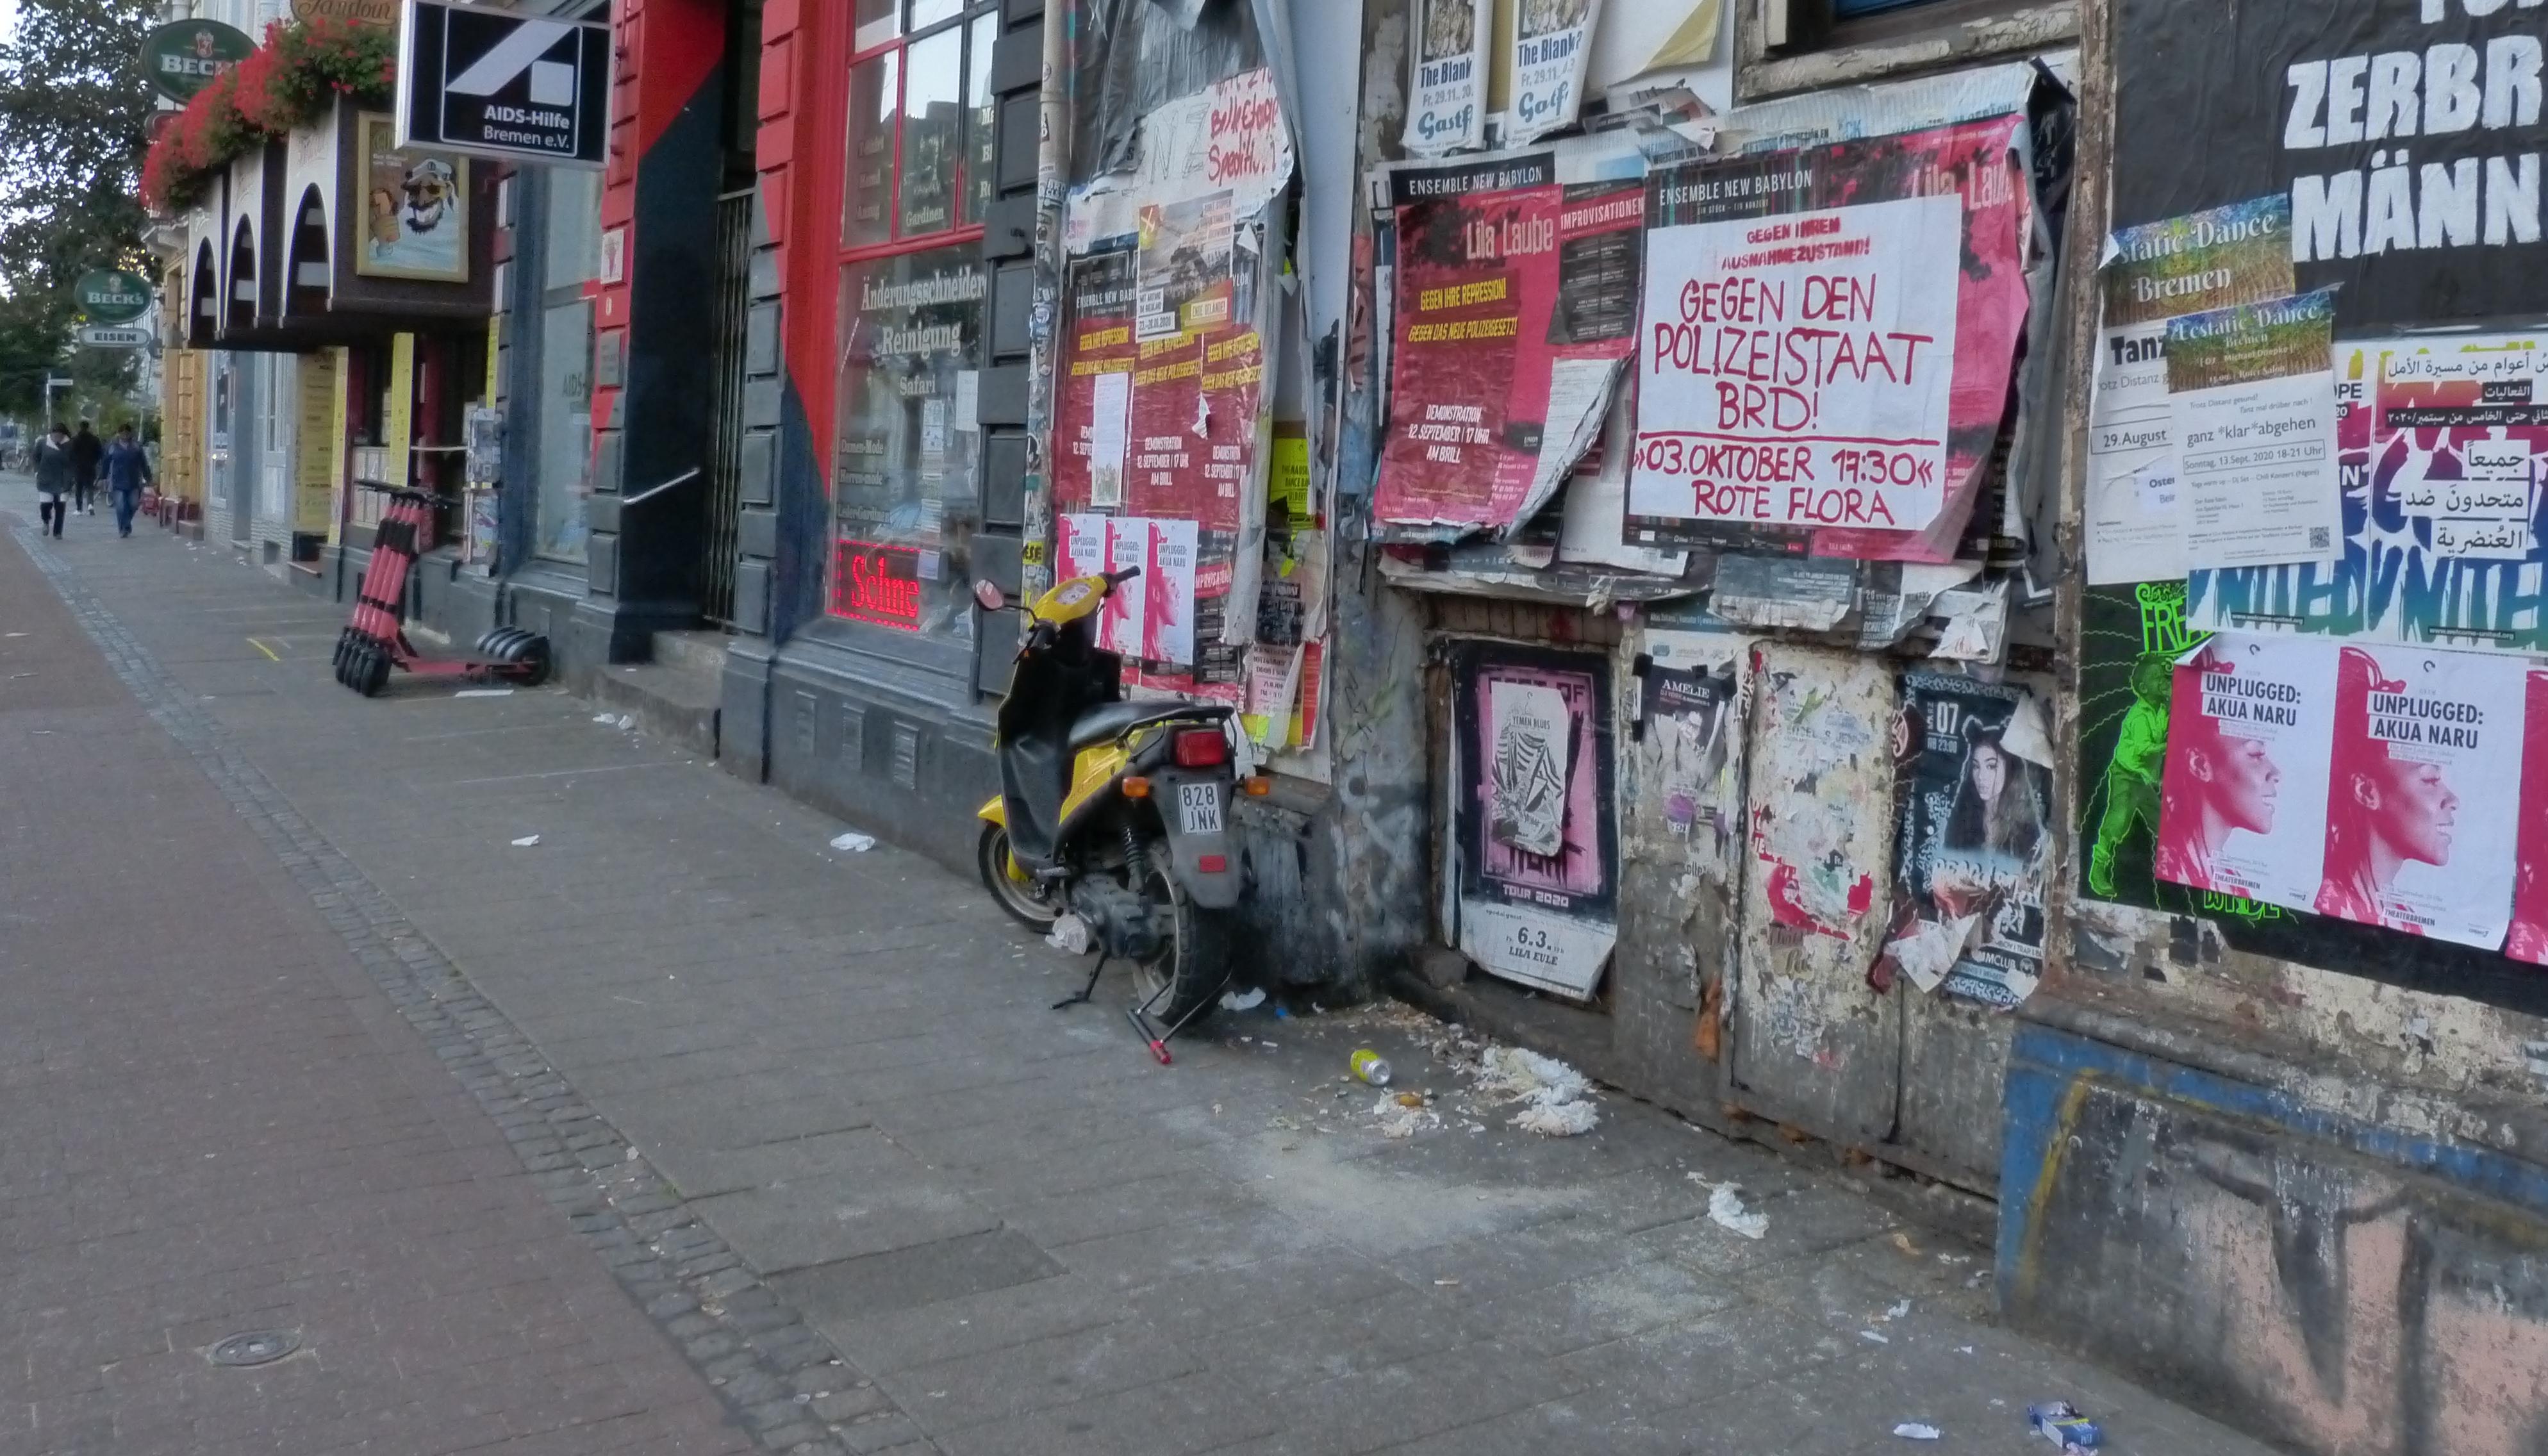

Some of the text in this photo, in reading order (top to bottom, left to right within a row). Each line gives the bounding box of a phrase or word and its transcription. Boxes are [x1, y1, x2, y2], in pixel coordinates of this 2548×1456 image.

[1518, 44, 1537, 67] The
[1421, 67, 1438, 88] The
[484, 104, 570, 129] AIDS-Hilfe
[484, 125, 570, 149] Bremen e.V.
[1410, 175, 1469, 196] ENSEMBLE
[1473, 172, 1494, 190] NEW
[1499, 165, 1543, 188] BABYLON
[1660, 169, 1813, 206] ENSEMBLE NEW BABYLON
[906, 206, 945, 227] Gardinen
[1561, 197, 1644, 231] IMPROVISATIONEN
[2292, 149, 2540, 262] MÄNN
[1467, 213, 1553, 260] Lila Laube
[1746, 224, 1791, 245] GEGEN
[2119, 213, 2274, 264] static Dance
[1421, 277, 1507, 312] GEGEN IHRE REPRESSION!
[2131, 267, 2231, 303] Bremen
[1105, 291, 1117, 304] NEW
[1680, 275, 1785, 326] GEGEN
[1801, 273, 1876, 323] DEN
[2253, 305, 2319, 330] Dance
[94, 332, 136, 342] EISEN
[881, 320, 961, 360] Reinigung
[1408, 317, 1518, 342] GEGEN DAS NEUE POLIZEIGESETZ!
[1654, 320, 1934, 388] POLIZEISTAAT
[2493, 351, 2530, 377] أعوام
[2388, 356, 2420, 377] الأمل
[2426, 360, 2463, 378] مسيرة
[2469, 360, 2488, 376] من
[900, 374, 936, 395] Safari
[2121, 374, 2159, 388] Distanz
[2483, 385, 2531, 399] الفعاليات
[1425, 403, 1482, 423] DEMONSTRATION
[1714, 381, 1819, 433] BRD!
[2449, 413, 2463, 424] من
[1409, 423, 1491, 445] 12. SEPTEMBER 17 UHR
[2103, 429, 2167, 448] 29.August
[2187, 431, 2214, 448] ganz
[1426, 445, 1461, 464] AM BRILL
[2253, 450, 2274, 462] 2020
[2276, 447, 2301, 459] 18-21
[2304, 445, 2323, 456] Uhr
[2467, 441, 2525, 475] جميعاً
[1691, 479, 1896, 526] ROTE FLORA
[2405, 488, 2435, 506] ضد
[1159, 557, 1171, 567] AKUA
[2429, 627, 2516, 640] www.welcome-united.org
[1662, 679, 1710, 699] AMELIE
[2206, 674, 2301, 704] UNPLUGGED:
[1936, 701, 1959, 735] 07
[2207, 697, 2296, 727] AKUA NARU
[2373, 693, 2484, 725] UNPLUGGED:
[1512, 715, 1532, 728] YEMEN
[2374, 718, 2478, 750] AKUA NARU
[1182, 786, 1215, 806] 828
[1190, 809, 1218, 831] JNK
[2214, 873, 2261, 890] THEATERBREMEN
[1503, 884, 1569, 908] TOUR 2020
[2384, 909, 2435, 926] THEATERBREMEN
[1509, 945, 1559, 966] LILA EULE
